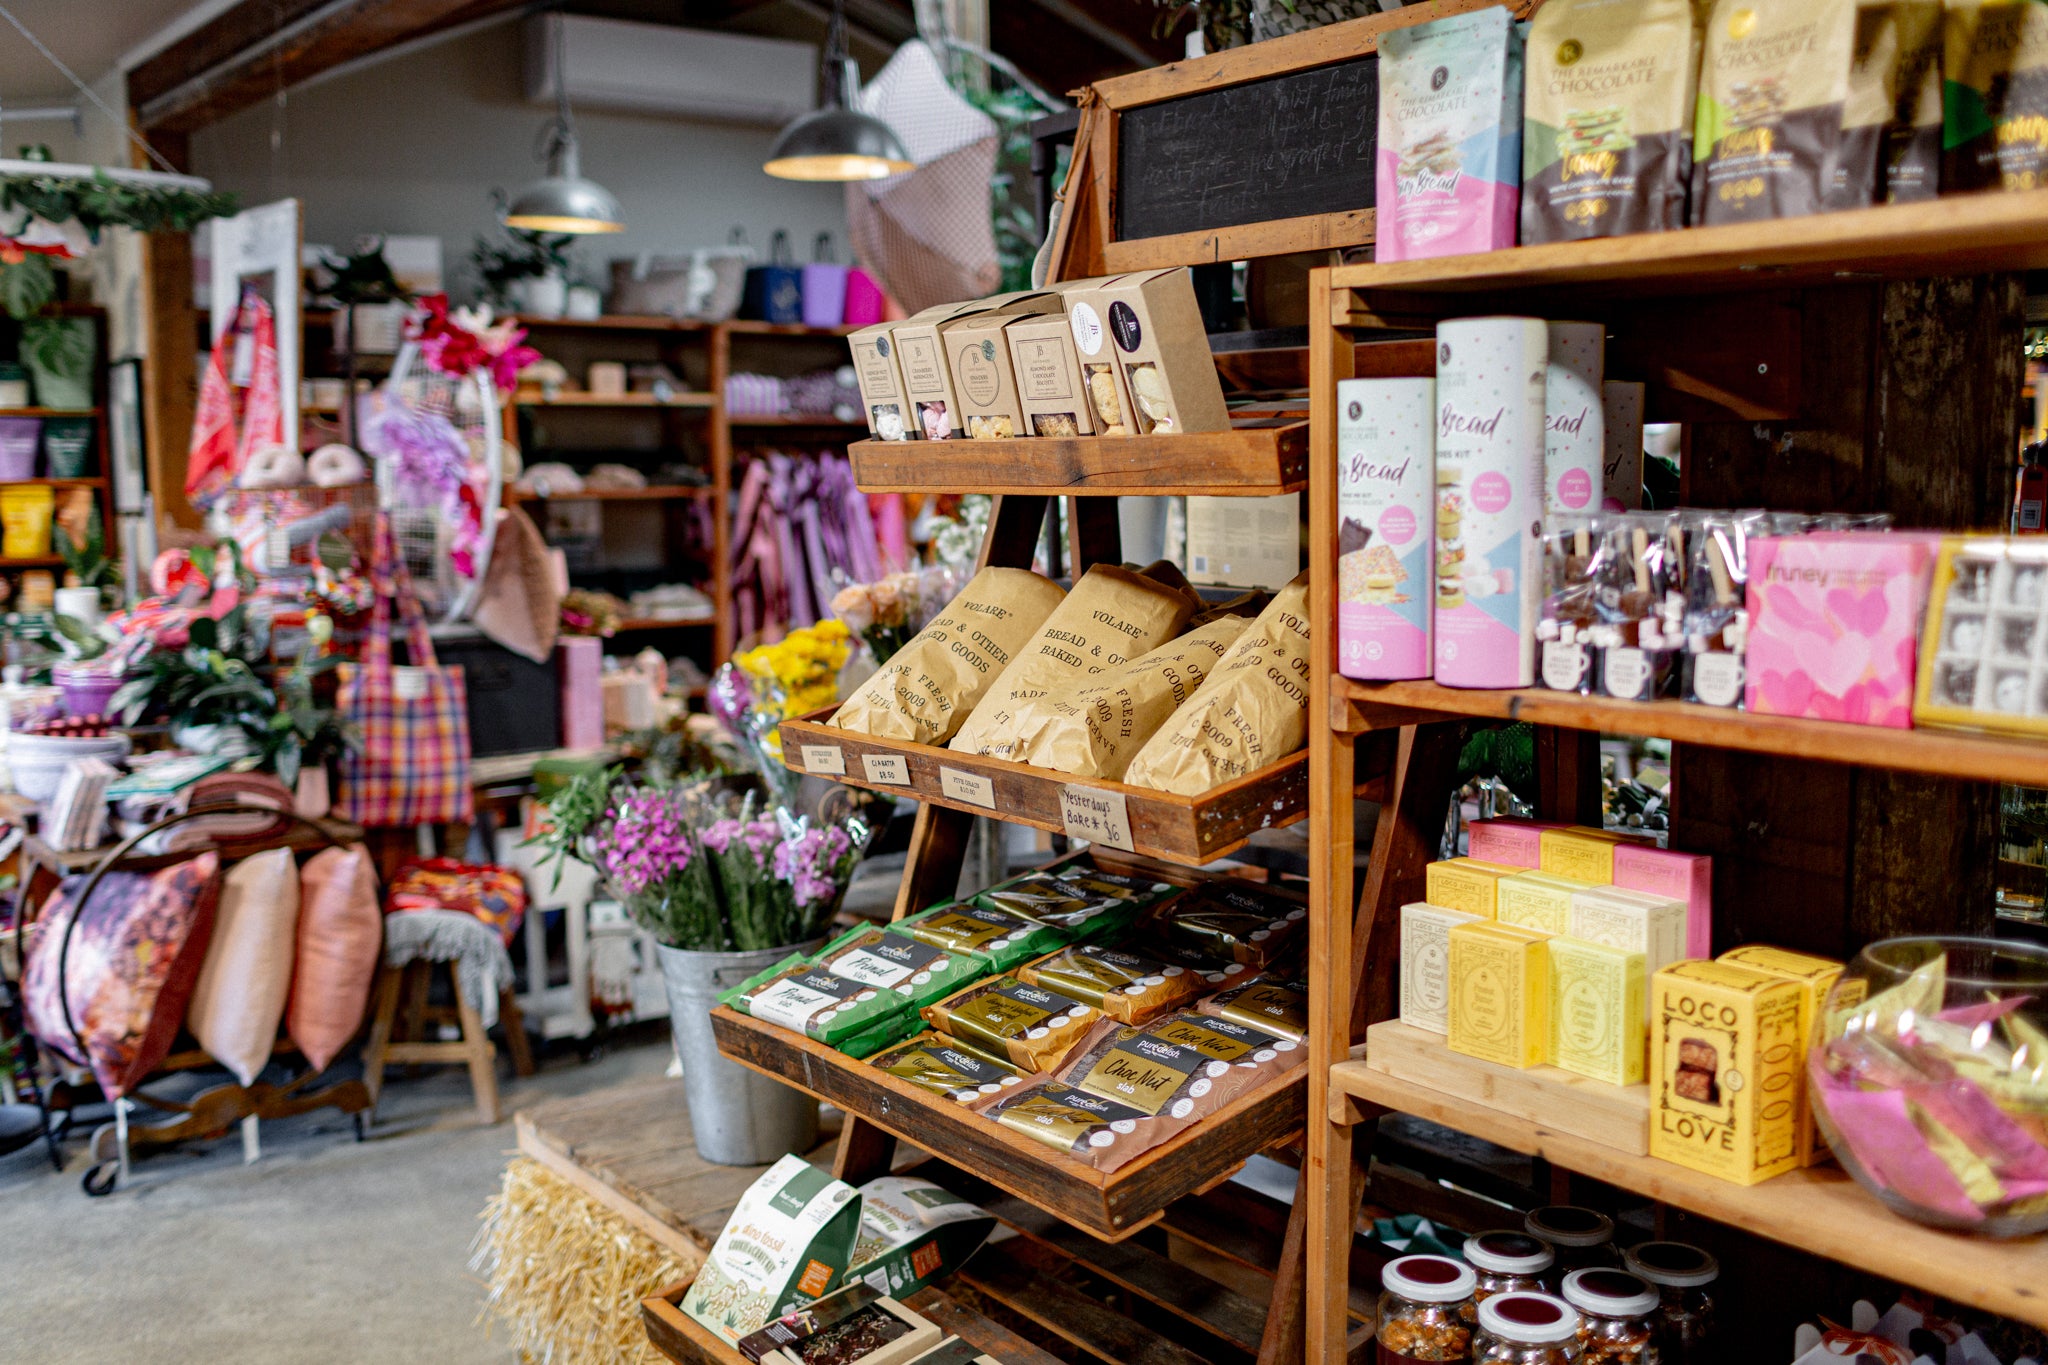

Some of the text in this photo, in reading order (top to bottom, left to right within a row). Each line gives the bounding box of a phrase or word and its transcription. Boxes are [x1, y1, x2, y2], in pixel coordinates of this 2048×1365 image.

[1549, 67, 1656, 96] CHOCOLATE
[1398, 97, 1468, 121] CHOCOLATE
[1416, 166, 1463, 196] Bread
[1440, 402, 1504, 440] Bread
[1545, 406, 1587, 440] ead
[1350, 452, 1411, 487] Bread
[963, 601, 1007, 620] VOLARE
[1092, 610, 1143, 639] VOLARE
[956, 623, 966, 632] &
[971, 631, 1009, 665] OTHER
[1044, 628, 1086, 647] BREAD
[1090, 644, 1101, 657] &
[1273, 648, 1285, 657] &
[951, 641, 990, 673] GOODS
[1039, 645, 1082, 668] BAKED
[898, 687, 926, 707] 2009
[918, 674, 951, 712] FRESH
[1267, 667, 1310, 709] GOODS
[1116, 688, 1134, 738] FRESH
[1085, 716, 1116, 756] BAKED
[1202, 720, 1233, 748] 2009
[1224, 707, 1262, 755] FRESH
[1063, 789, 1111, 818] Yesterdays
[1067, 808, 1120, 843] Bake $6
[1484, 834, 1522, 847] LOCO LOVE
[1555, 847, 1594, 860] LOCO LOVE
[1441, 879, 1476, 892] LOCO LOVE
[1513, 893, 1552, 907] LOCO LOVE
[1416, 922, 1432, 931] LOCO
[1587, 909, 1627, 925] LOCO LOVE
[1465, 944, 1505, 958] LOCO LOVE
[1565, 957, 1606, 971] LOCO LOVE
[850, 957, 898, 978] Primal
[775, 987, 823, 1006] Primal
[1664, 991, 1737, 1027] LOCO
[986, 1013, 1002, 1023] slab
[1264, 1006, 1284, 1015] slab
[1137, 1040, 1180, 1059] puredelish
[1167, 1028, 1237, 1054] Choc Nut
[940, 1049, 984, 1072] puredelish
[1104, 1058, 1173, 1092] Choc Nut
[1116, 1082, 1135, 1095] slab
[1034, 1115, 1054, 1126] slab
[1661, 1112, 1736, 1151] LOVE
[742, 1224, 786, 1253] dino fossil
